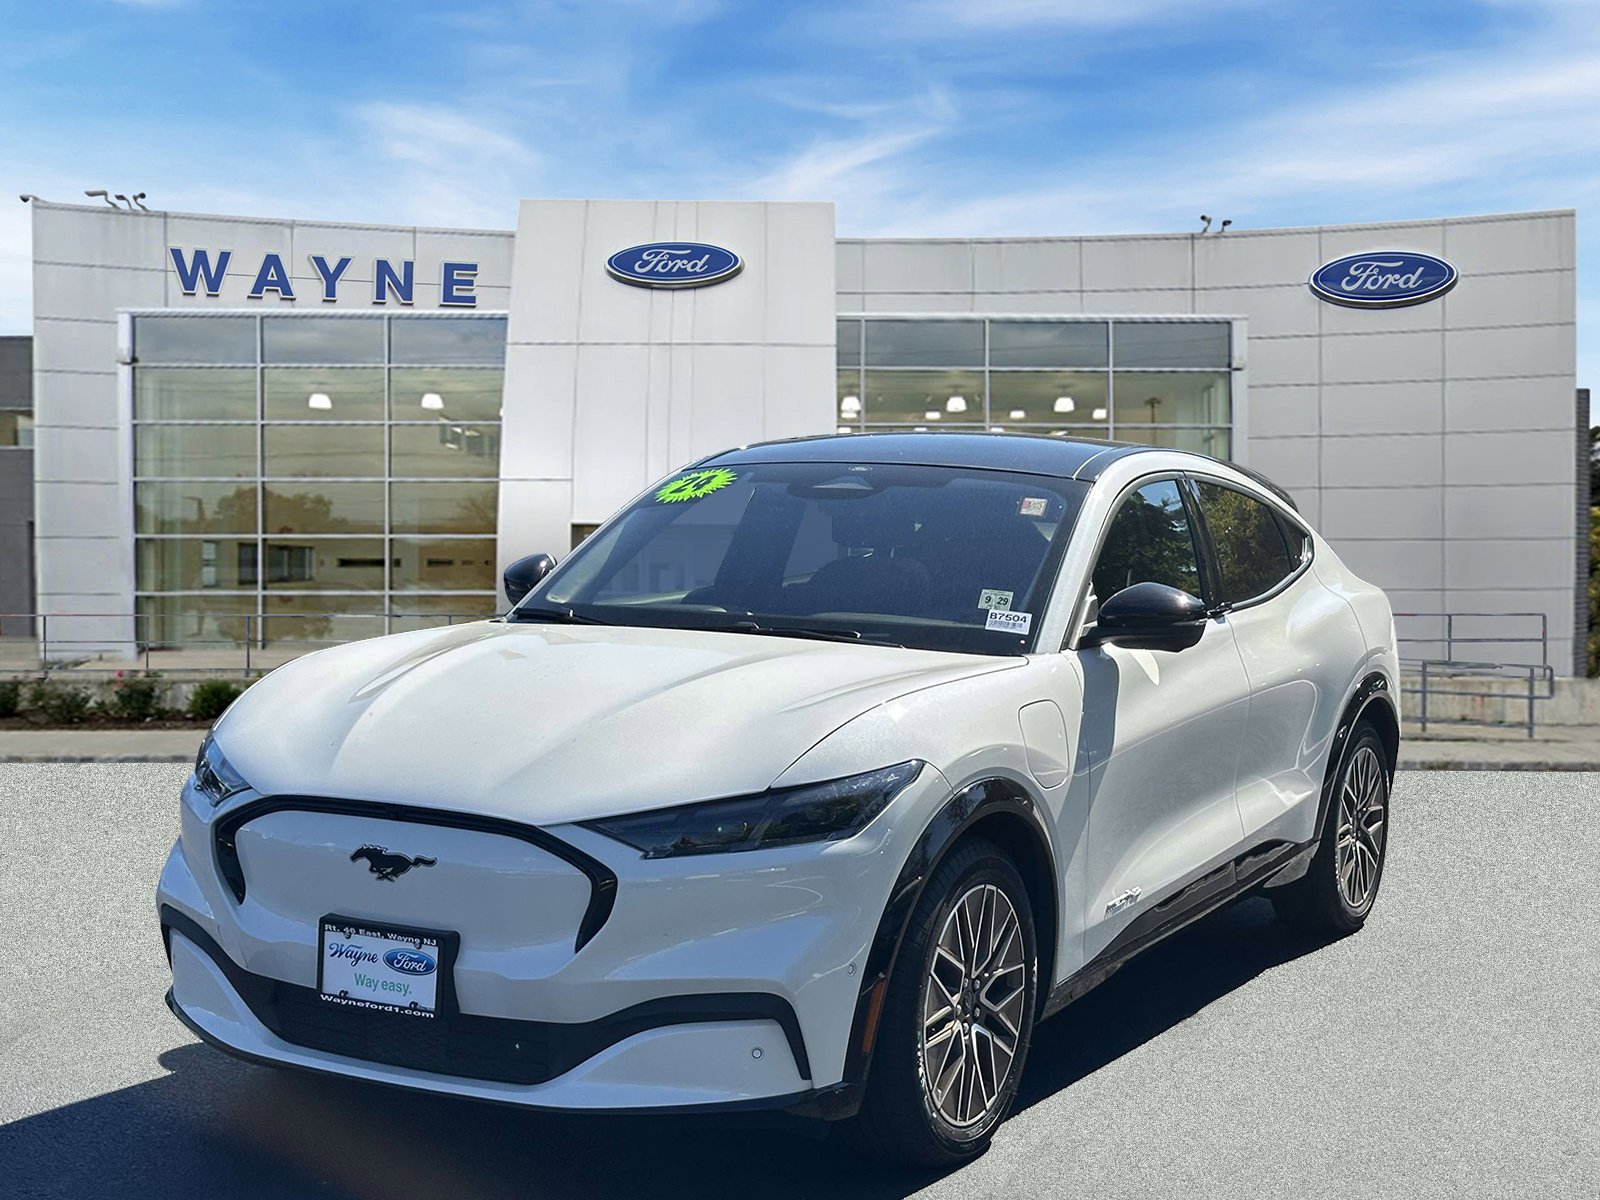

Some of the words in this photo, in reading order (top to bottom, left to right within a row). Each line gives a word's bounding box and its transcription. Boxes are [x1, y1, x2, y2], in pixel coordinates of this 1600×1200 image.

[633, 248, 710, 273] Ford
[168, 246, 479, 307] WAYNE
[1340, 260, 1425, 291] Ford
[984, 595, 992, 604] 9
[996, 596, 1009, 606] 29
[989, 612, 1027, 623] B7504
[387, 932, 421, 944] Wayne
[423, 938, 437, 946] NJ
[328, 942, 379, 967] Wayne
[393, 951, 427, 972] Ford
[354, 973, 379, 992] Way
[381, 980, 412, 997] easy.
[320, 993, 434, 1019] Wayneford1.com
